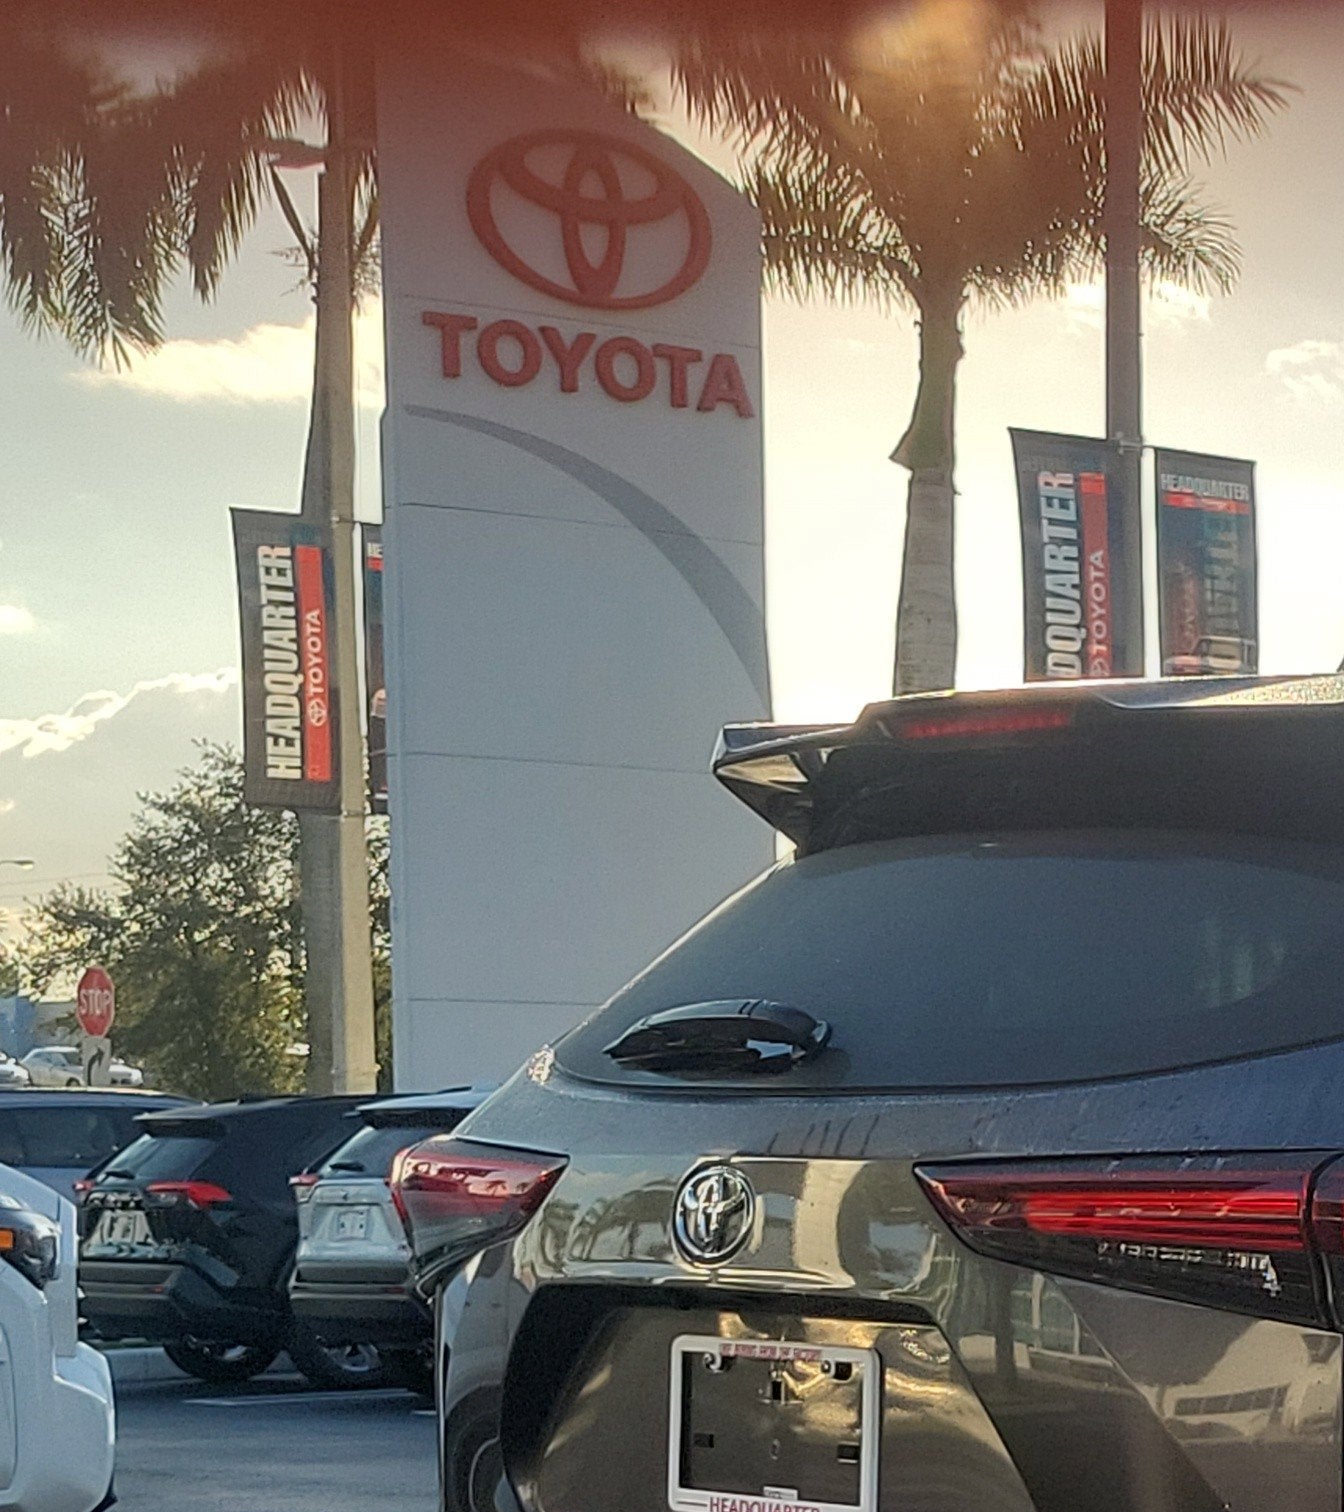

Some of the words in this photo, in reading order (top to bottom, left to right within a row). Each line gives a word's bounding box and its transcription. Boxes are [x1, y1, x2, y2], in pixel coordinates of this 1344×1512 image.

[422, 311, 754, 418] TOYOTA
[1038, 471, 1086, 677] DQUARTER
[1089, 551, 1108, 654] TOYOTA
[257, 545, 304, 780] HEADQUARTER
[305, 608, 324, 695] TOYOTA
[79, 989, 111, 1015] STOP
